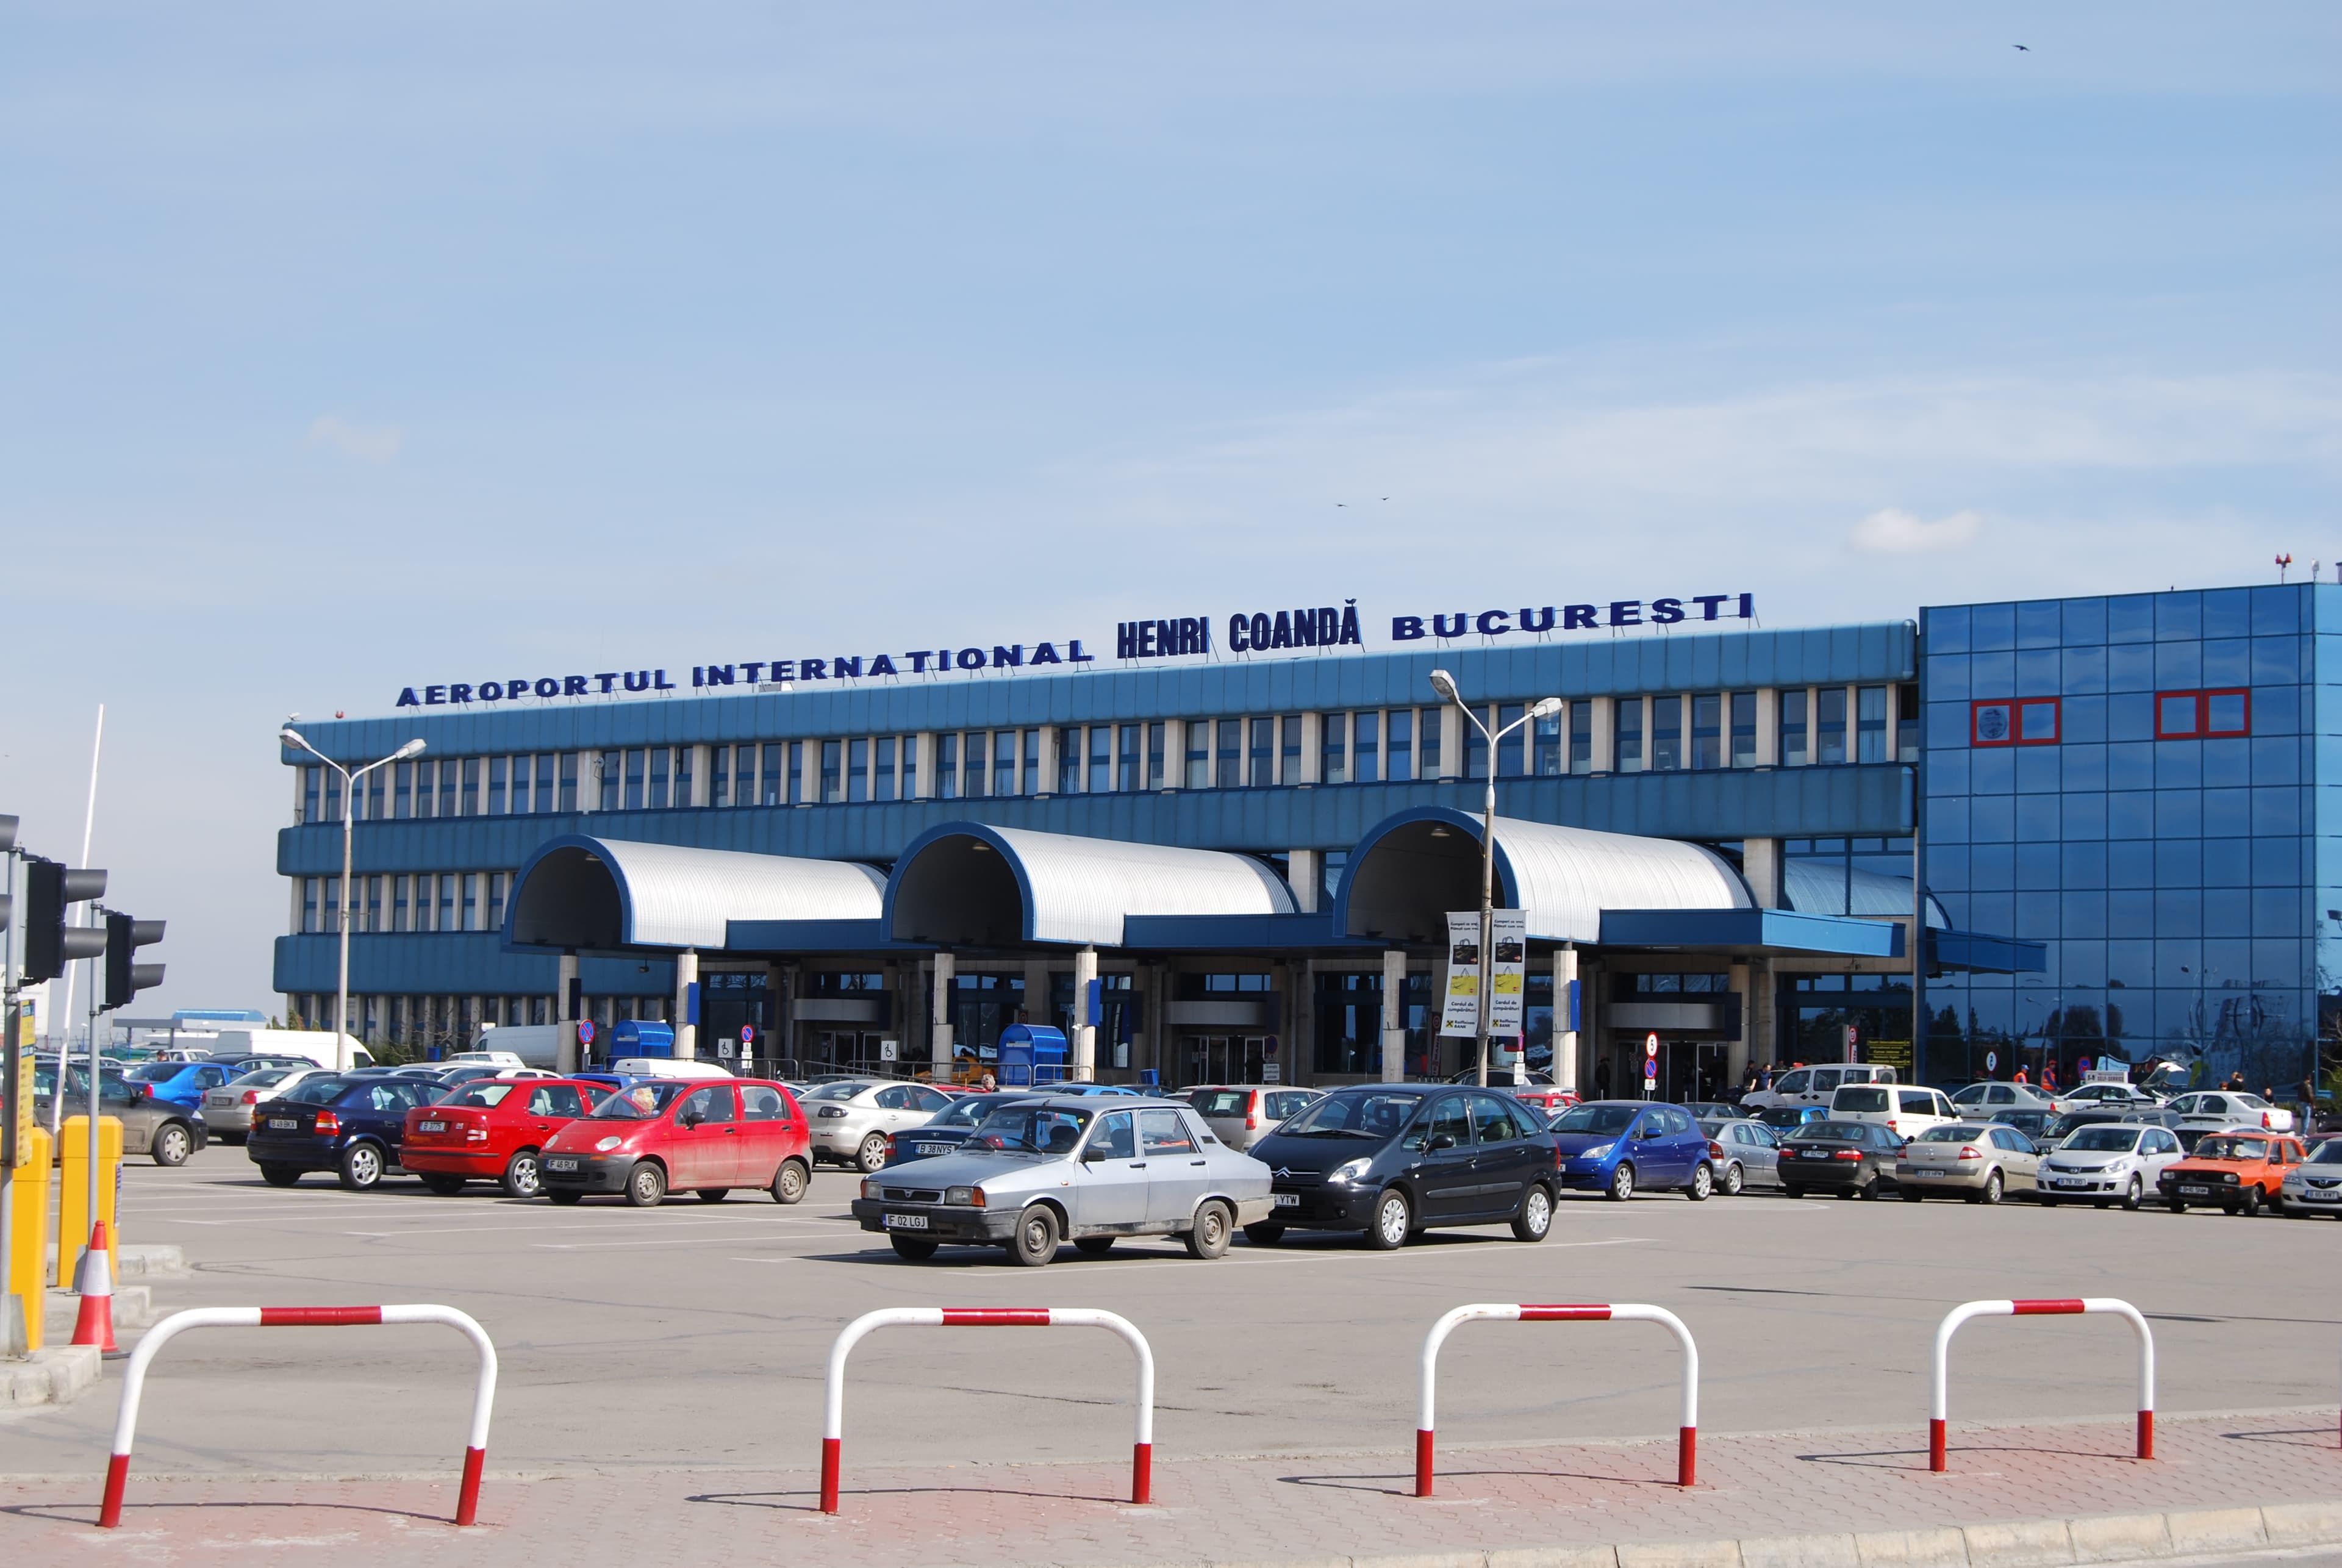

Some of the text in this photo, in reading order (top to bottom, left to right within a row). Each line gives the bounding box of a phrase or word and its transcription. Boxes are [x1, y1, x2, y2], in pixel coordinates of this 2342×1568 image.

[396, 593, 1753, 706] AEROPORTUL INTERNATIONAL HENRI COANDĂ BUCURESTI
[1650, 1039, 1654, 1051] 5
[937, 1145, 952, 1154] NYS
[1280, 1195, 1297, 1205] YTW
[888, 1215, 925, 1227] IF 02 LGJ
